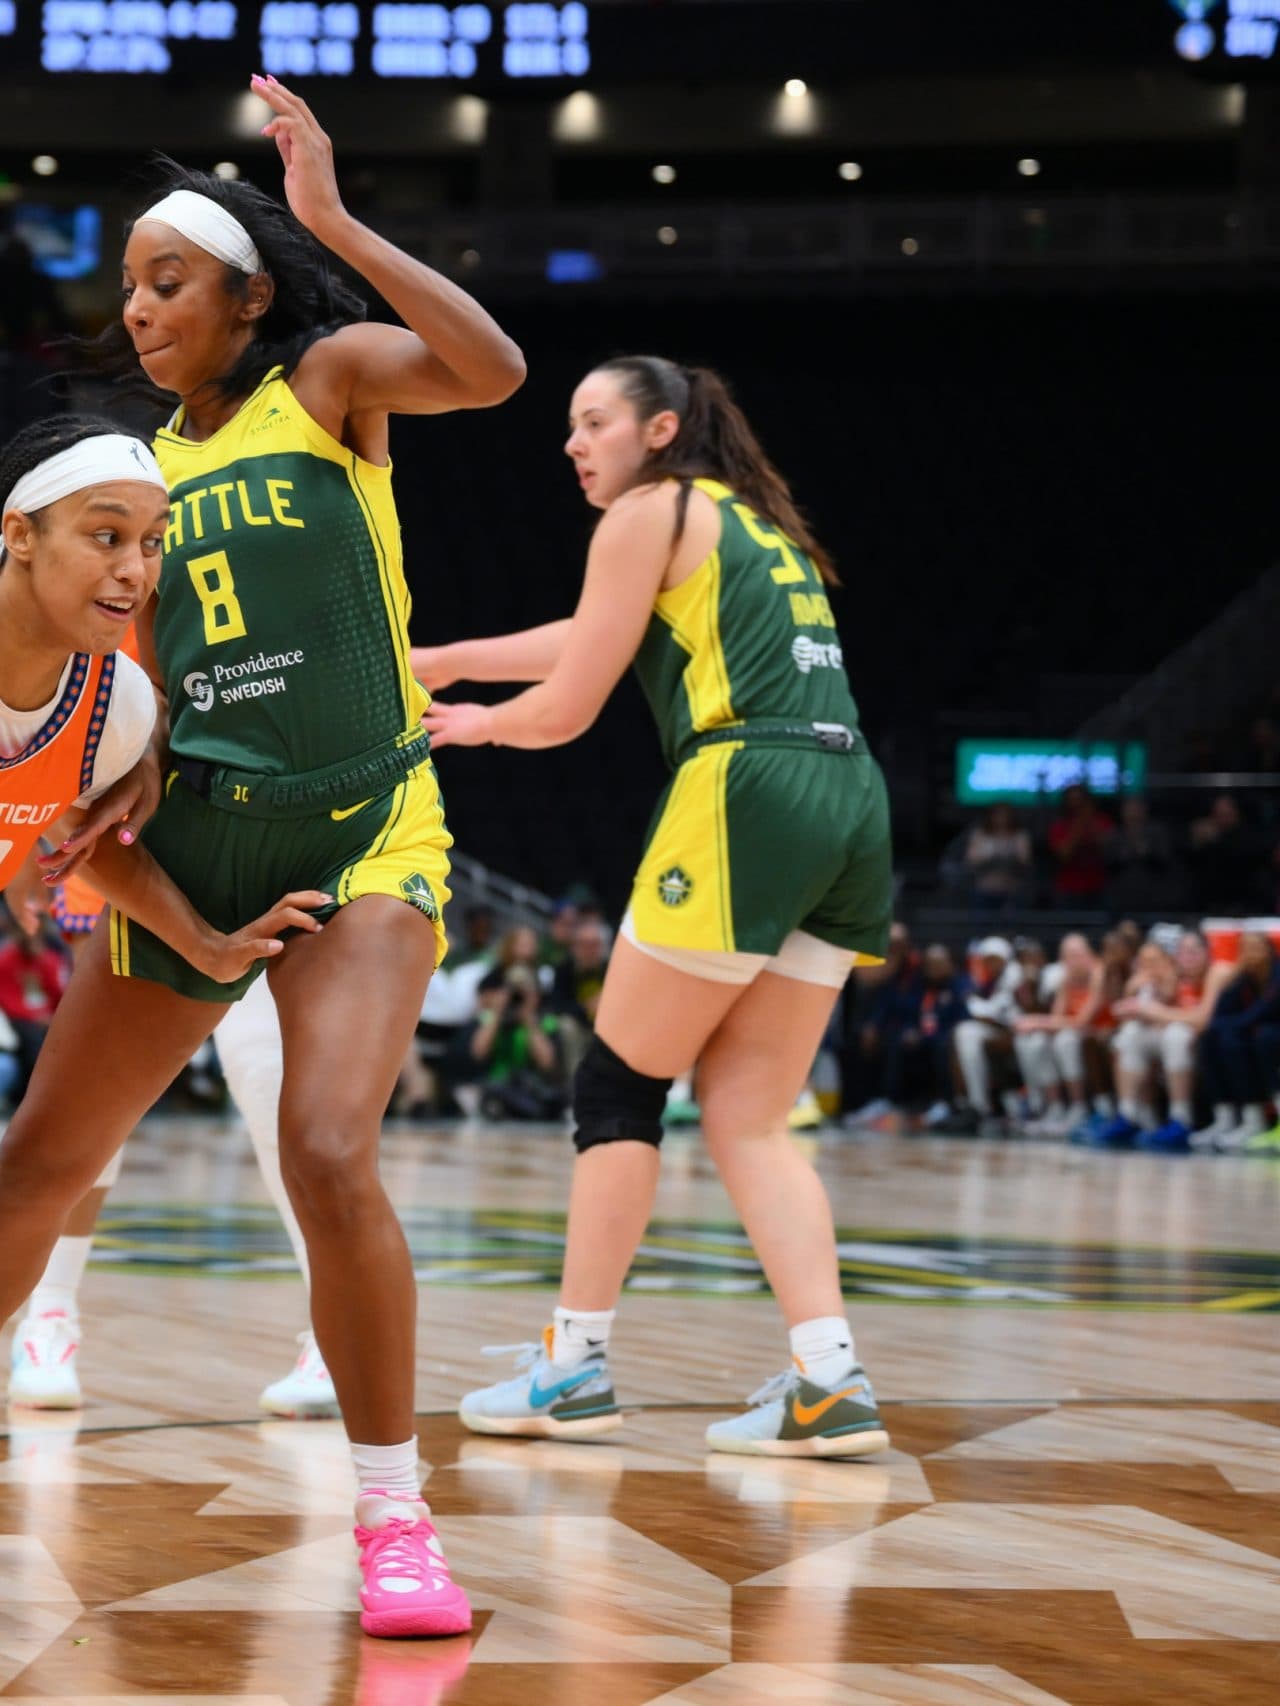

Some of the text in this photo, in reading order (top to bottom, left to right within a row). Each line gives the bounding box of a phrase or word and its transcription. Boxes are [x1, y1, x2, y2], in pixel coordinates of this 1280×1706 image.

[162, 479, 305, 555] ATTLE
[187, 550, 247, 646] 8
[213, 649, 305, 683] Providence
[220, 677, 286, 704] SWEDISH
